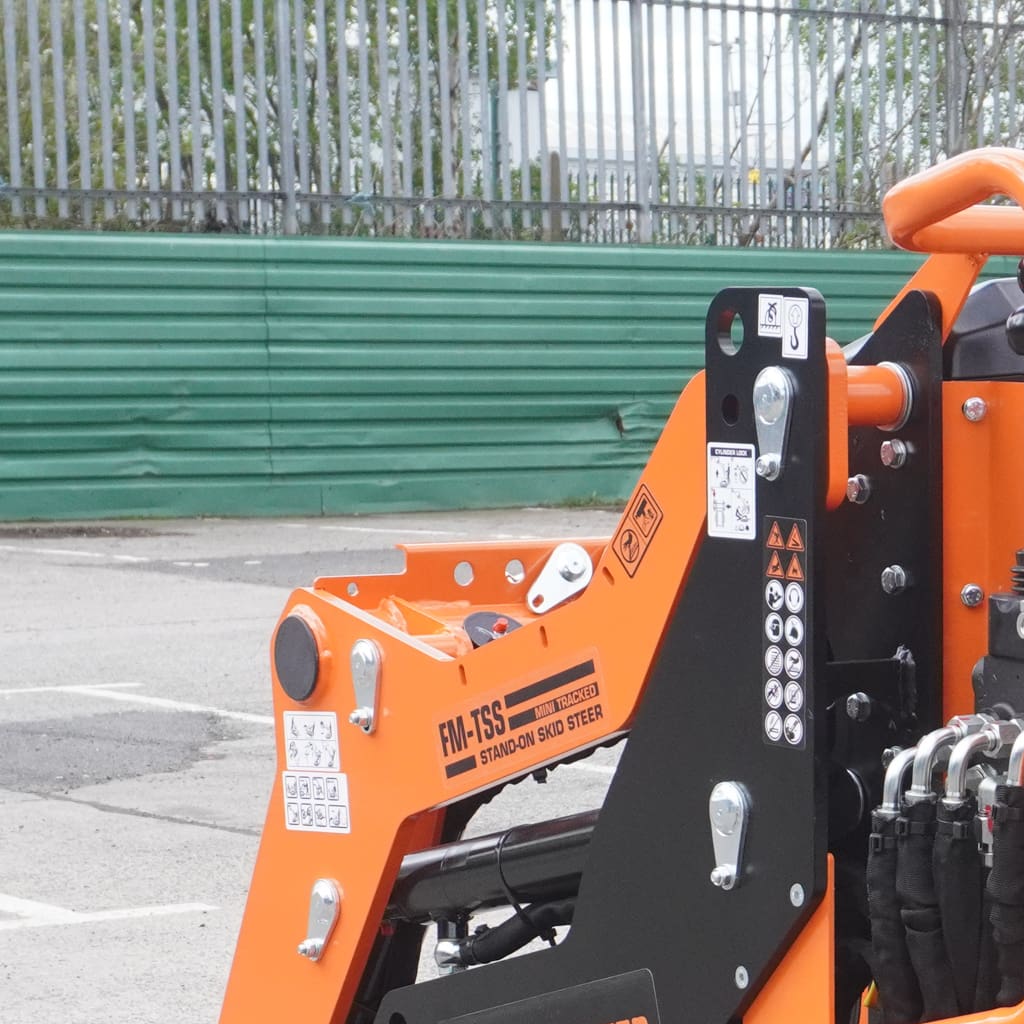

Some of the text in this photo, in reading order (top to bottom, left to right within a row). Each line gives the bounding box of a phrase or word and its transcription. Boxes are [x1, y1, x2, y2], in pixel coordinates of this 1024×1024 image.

[438, 700, 506, 757] FM-TSS
[534, 684, 597, 720] MINI TRACKED
[480, 704, 604, 765] STAND-ON SKID STEER
